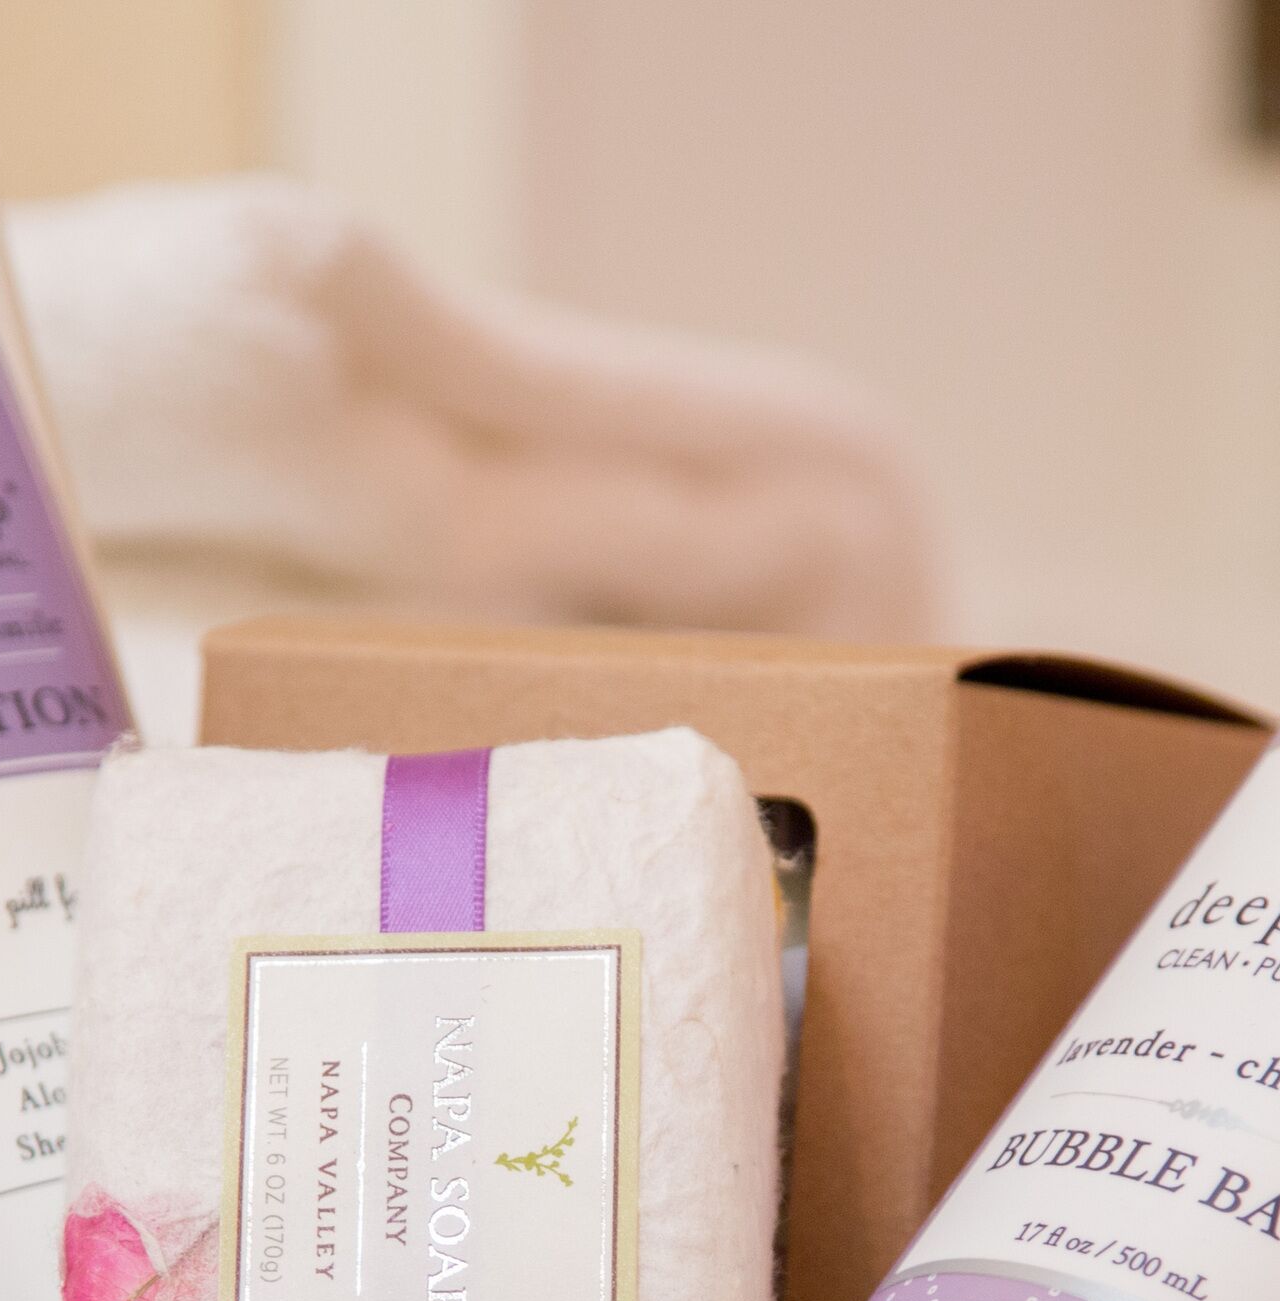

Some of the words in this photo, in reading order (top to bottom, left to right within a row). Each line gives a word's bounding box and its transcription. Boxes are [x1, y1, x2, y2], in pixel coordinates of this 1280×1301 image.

[6, 876, 49, 930] pill
[1156, 949, 1235, 972] CLEAN
[269, 1057, 288, 1098] NET
[1056, 1030, 1197, 1067] lavender
[319, 1060, 341, 1145] NAPA
[432, 1016, 475, 1160] NAPA
[267, 1107, 288, 1145] WT.
[264, 1172, 286, 1205] OZ
[267, 1153, 285, 1166] 6
[385, 1093, 414, 1246] COMPANY
[986, 1129, 1199, 1194] BUBBLE
[259, 1214, 285, 1284] (170g)
[315, 1158, 338, 1281] VALLEY
[1014, 1222, 1048, 1243] 17
[1044, 1226, 1067, 1248] fl
[1066, 1236, 1096, 1255] oz
[1112, 1245, 1162, 1278] 500
[1162, 1268, 1209, 1301] mL
